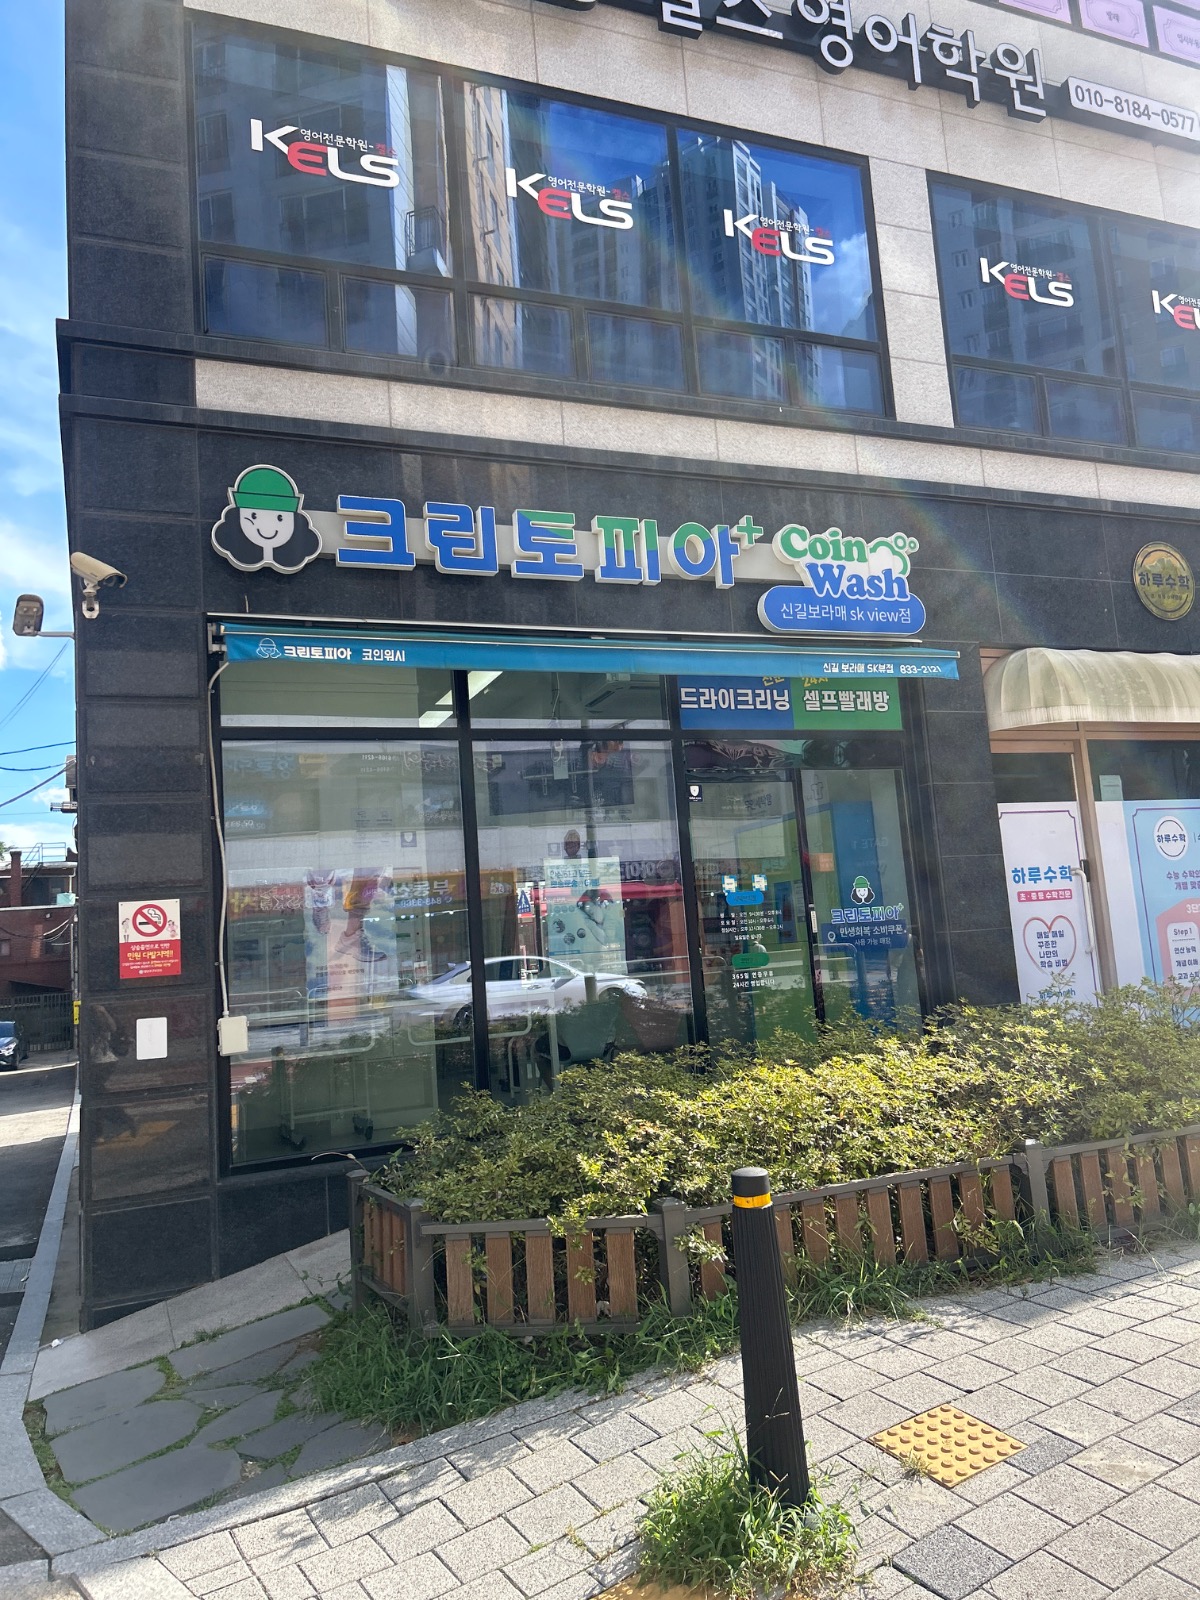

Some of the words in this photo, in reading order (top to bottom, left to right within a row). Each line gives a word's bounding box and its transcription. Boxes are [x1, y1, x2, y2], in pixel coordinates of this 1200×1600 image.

[1074, 85, 1195, 133] 010-8184-0577
[250, 118, 400, 188] KELS
[505, 167, 634, 230] KELS
[723, 208, 835, 266] KELS
[979, 257, 1075, 308] KELS
[779, 526, 868, 563] Coin
[805, 562, 910, 601] Wash
[1138, 572, 1190, 590] 하루수학
[780, 602, 847, 621] 신길보라매
[850, 606, 865, 621] sk
[867, 607, 912, 625] view점
[283, 645, 352, 660] 크린토피아
[361, 648, 406, 662] 코인워시
[823, 663, 839, 673] 신길
[867, 663, 894, 674] SK뷰점
[899, 664, 942, 674] 833-2121
[680, 687, 791, 711] 드라이크리닝
[803, 689, 890, 713] 셀프빨래방
[1157, 833, 1186, 843] 하루수학
[1012, 865, 1073, 885] 하루수학
[1166, 871, 1180, 880] 수능
[840, 926, 870, 938] 민생회복
[873, 924, 903, 935] 소비쿠폰
[1036, 931, 1050, 939] 매일
[1052, 930, 1065, 938] 매일
[1038, 940, 1057, 949] 꾸준한
[127, 951, 141, 960] 민원
[1039, 950, 1058, 959] 나만의
[1040, 960, 1053, 968] 학습
